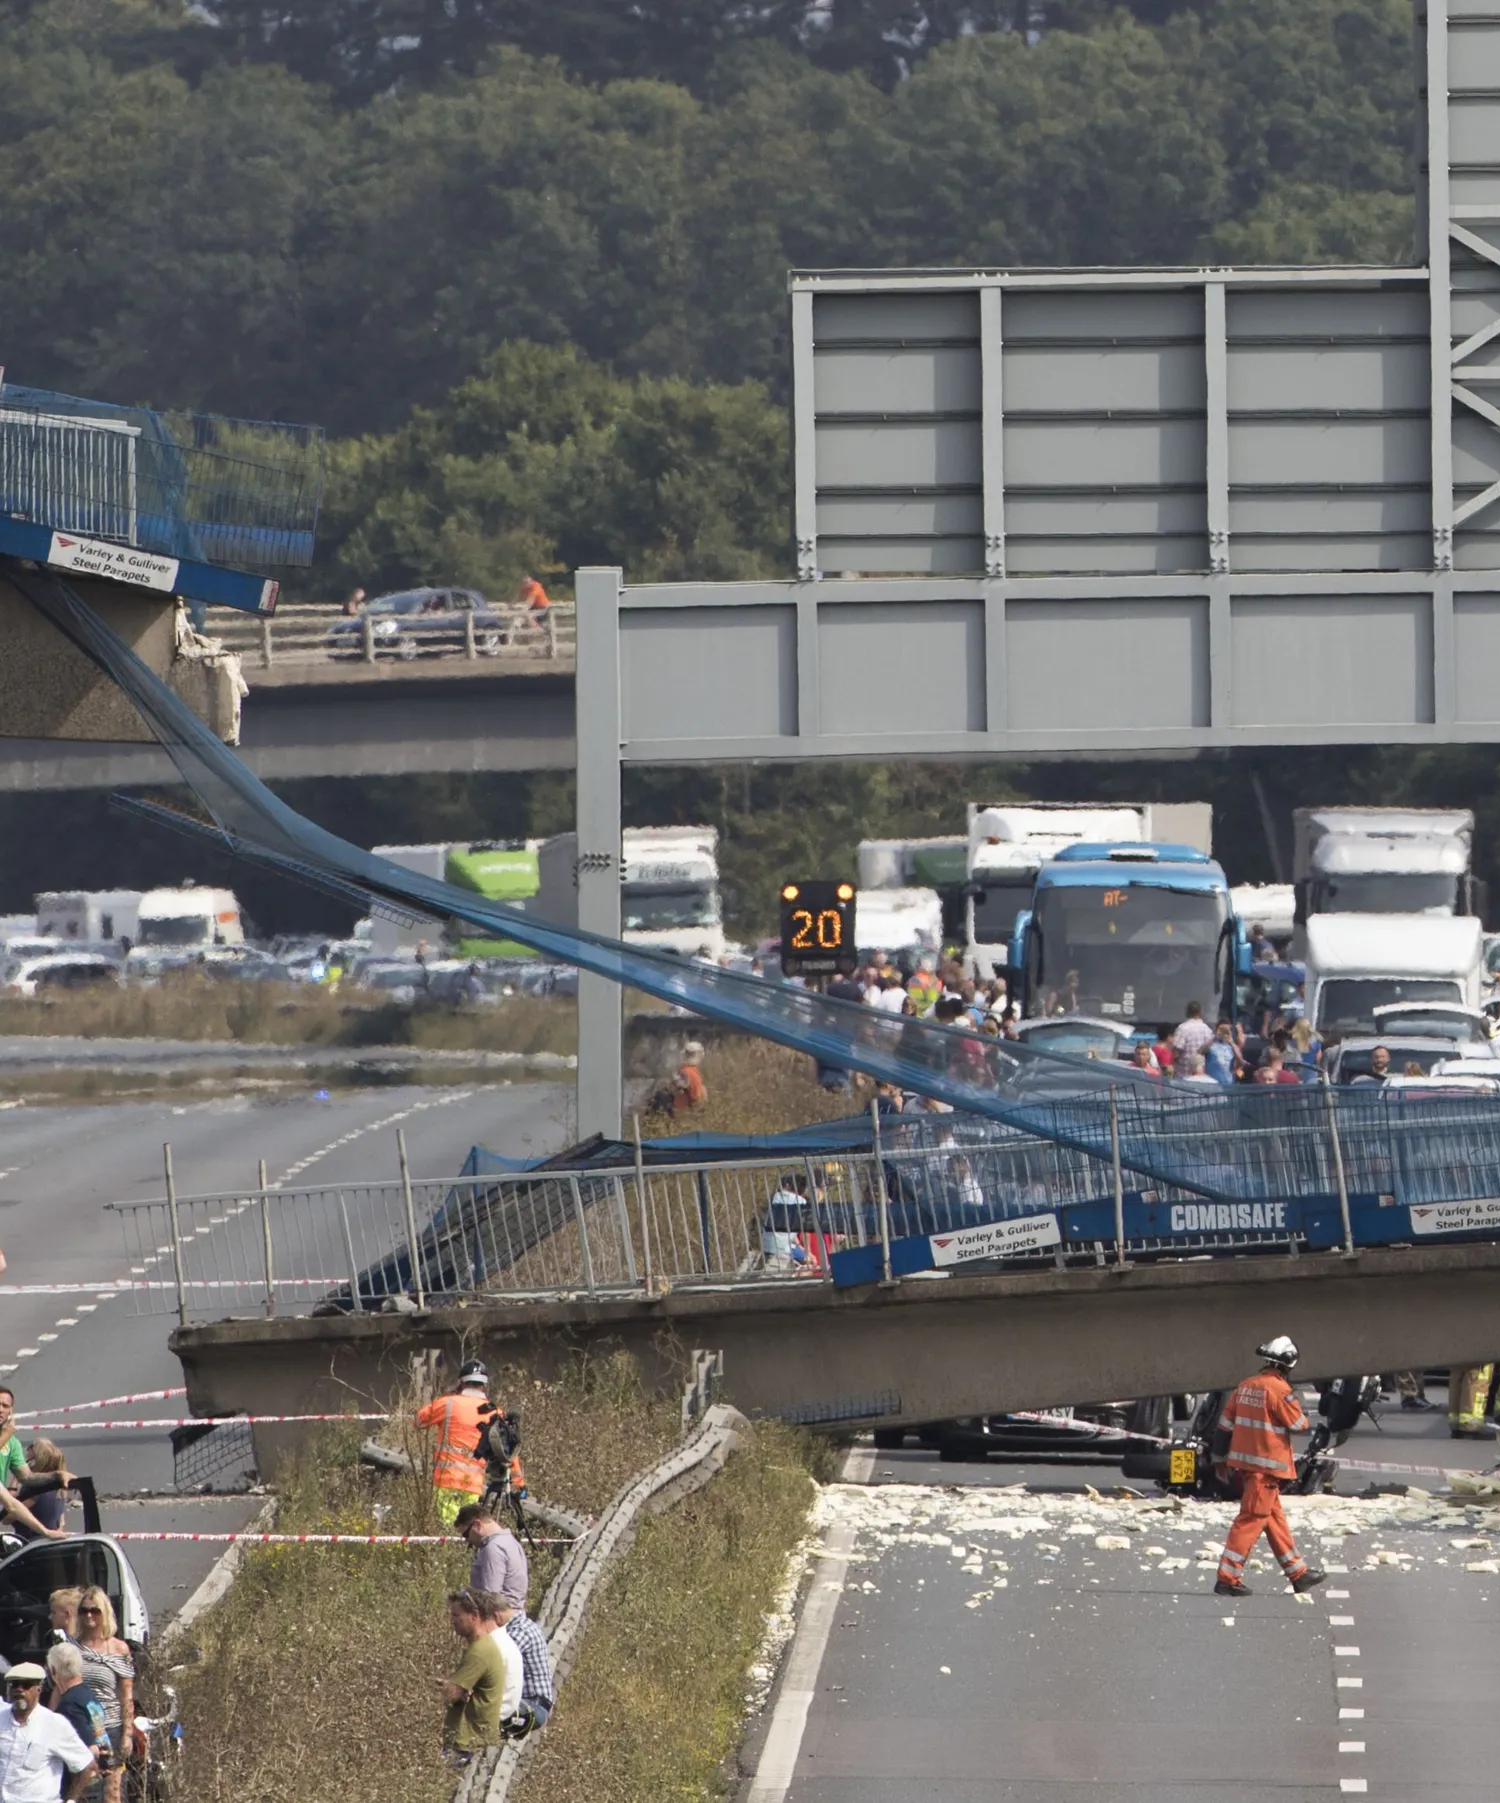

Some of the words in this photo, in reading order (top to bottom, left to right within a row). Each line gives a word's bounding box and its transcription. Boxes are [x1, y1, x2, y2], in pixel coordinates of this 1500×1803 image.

[72, 556, 100, 572] Steel
[103, 564, 151, 583] Parapets
[79, 543, 115, 562] Varley
[116, 553, 125, 562] &
[129, 556, 171, 574] Gulliver
[791, 909, 842, 948] 20
[1171, 1202, 1286, 1232] COMBISAFE
[1437, 1206, 1471, 1217] Varley
[1475, 1204, 1483, 1213] &
[957, 1232, 993, 1246] Varley
[995, 1229, 1004, 1238] &
[1007, 1221, 1051, 1236] Gulliver
[1436, 1219, 1463, 1230] Steel
[956, 1247, 984, 1259] Steel
[987, 1237, 1037, 1253] Parapets
